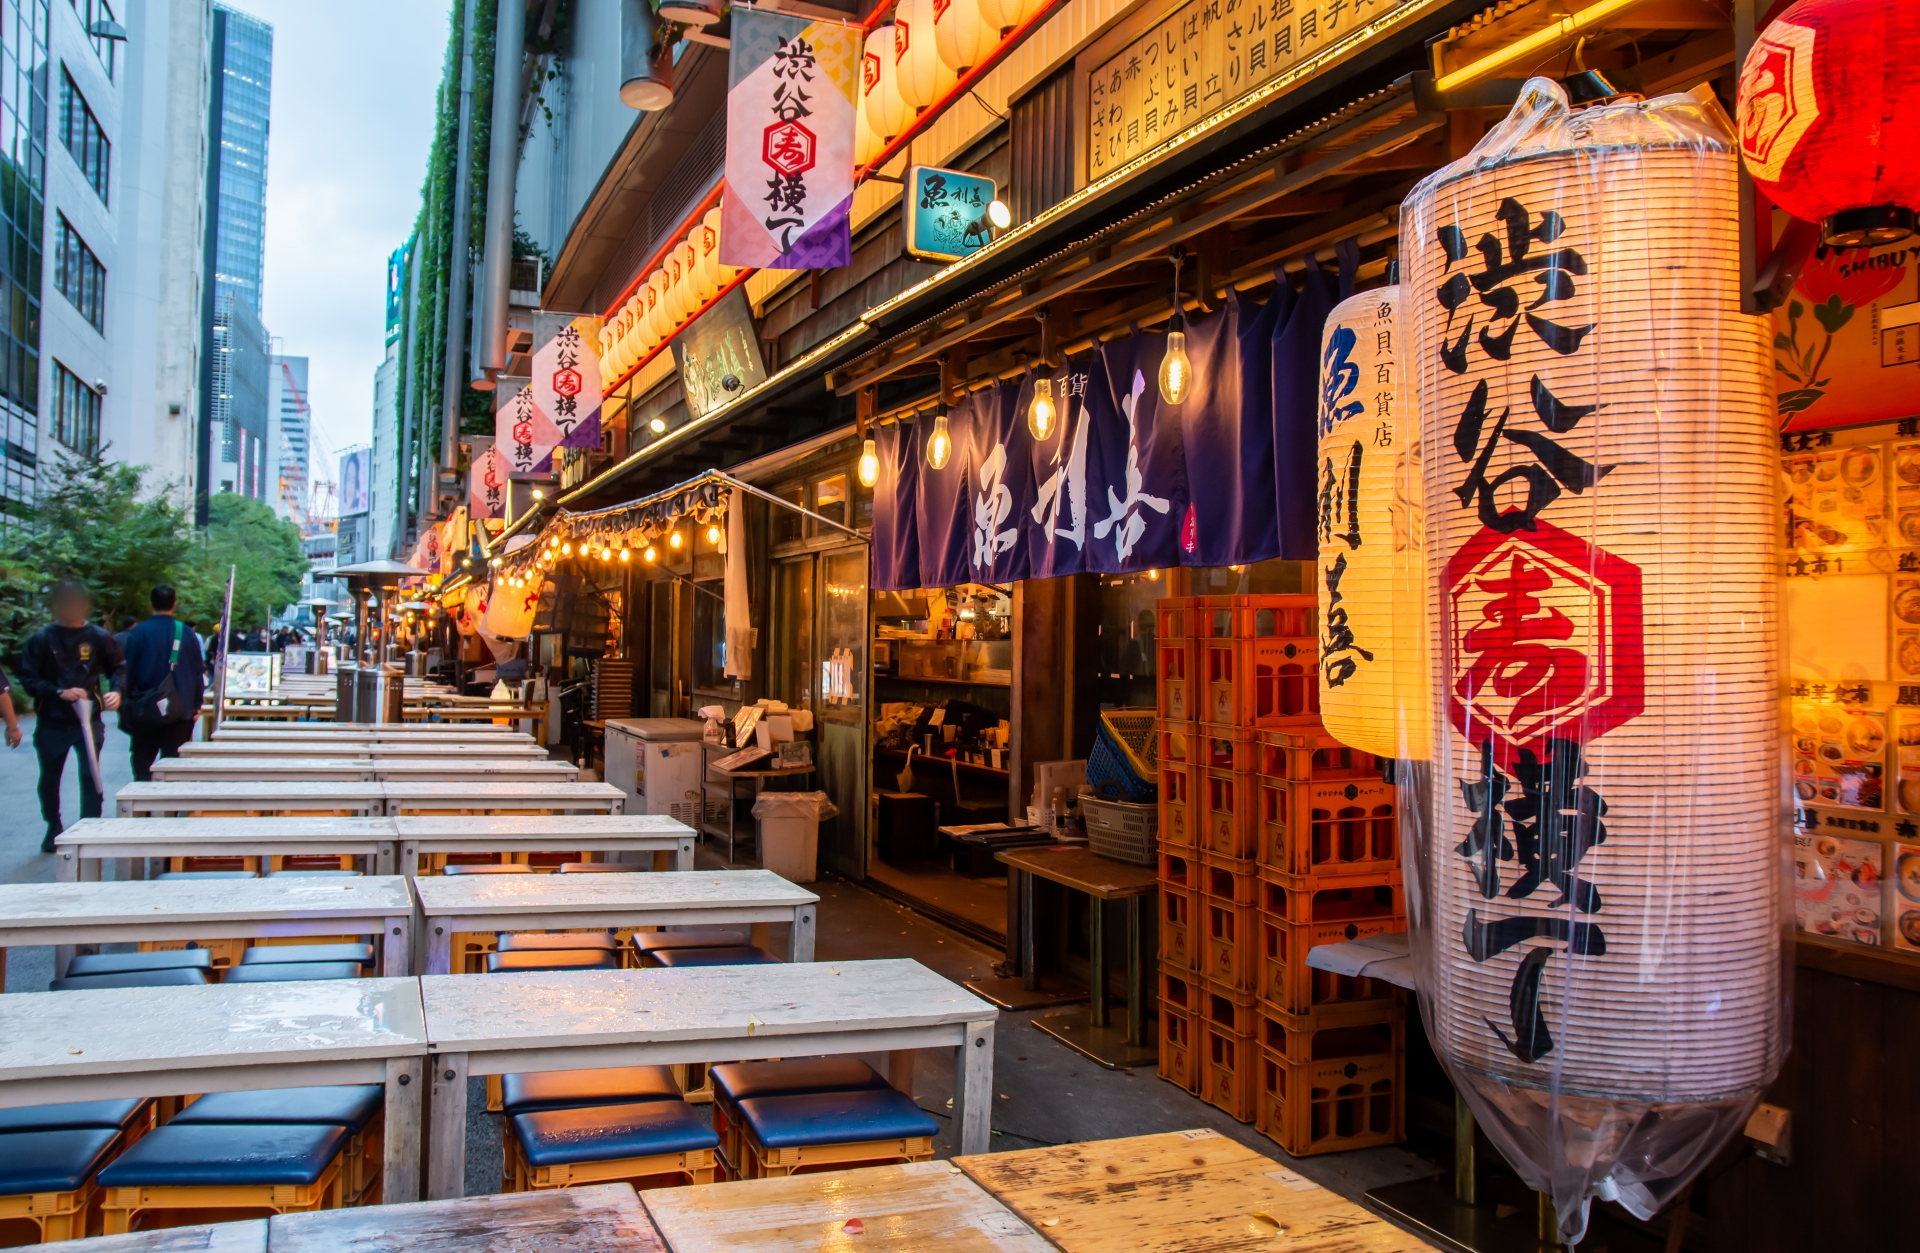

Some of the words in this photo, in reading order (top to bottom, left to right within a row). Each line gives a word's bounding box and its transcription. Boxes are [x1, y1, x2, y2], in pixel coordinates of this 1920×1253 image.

[1144, 42, 1159, 138] つぶ貝
[1163, 31, 1179, 127] しじみ
[1183, 10, 1199, 116] ばい貝
[1202, 0, 1222, 101] 帆立
[1093, 80, 1105, 167] さざえ
[1109, 68, 1123, 158] あわび
[1125, 56, 1141, 149] 赤貝
[1373, 302, 1395, 448] 魚貝百貨店
